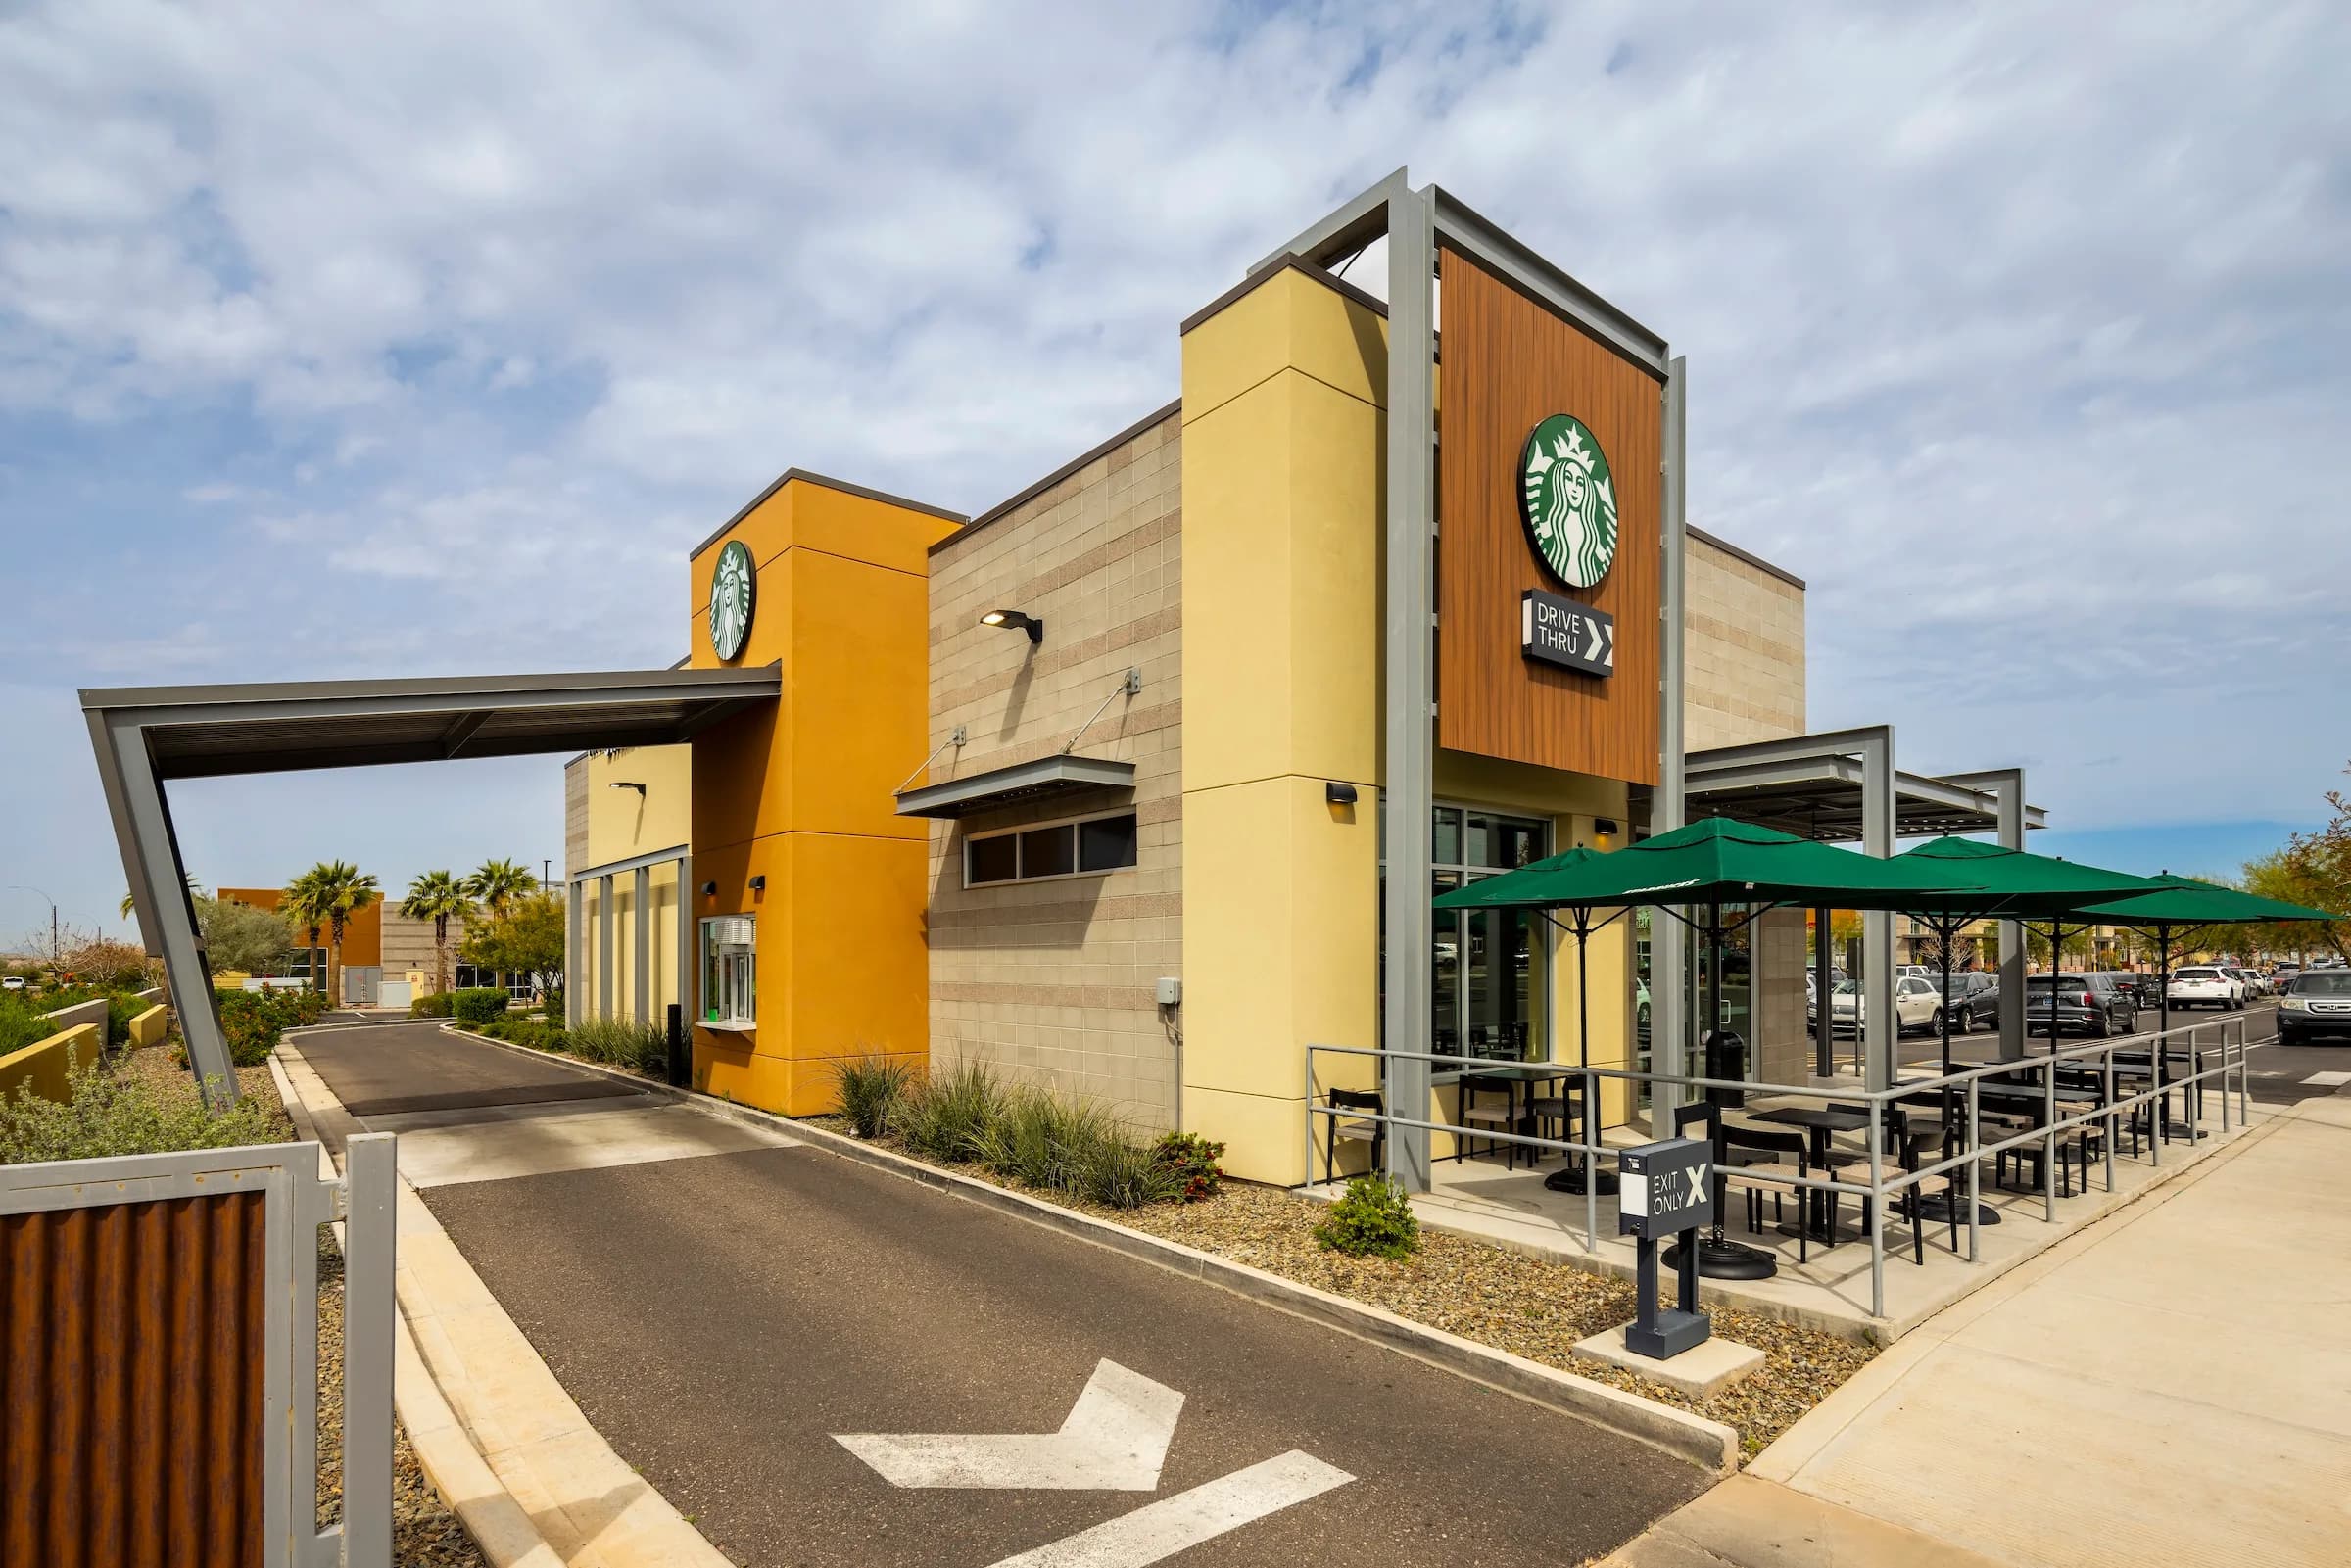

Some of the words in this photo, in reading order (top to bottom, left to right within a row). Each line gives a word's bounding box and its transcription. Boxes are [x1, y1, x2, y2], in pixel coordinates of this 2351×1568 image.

[1538, 602, 1580, 635] DRIVE
[1538, 625, 1577, 655] THRU
[1654, 1171, 1678, 1195] EXIT
[1654, 1191, 1684, 1215] ONLY
